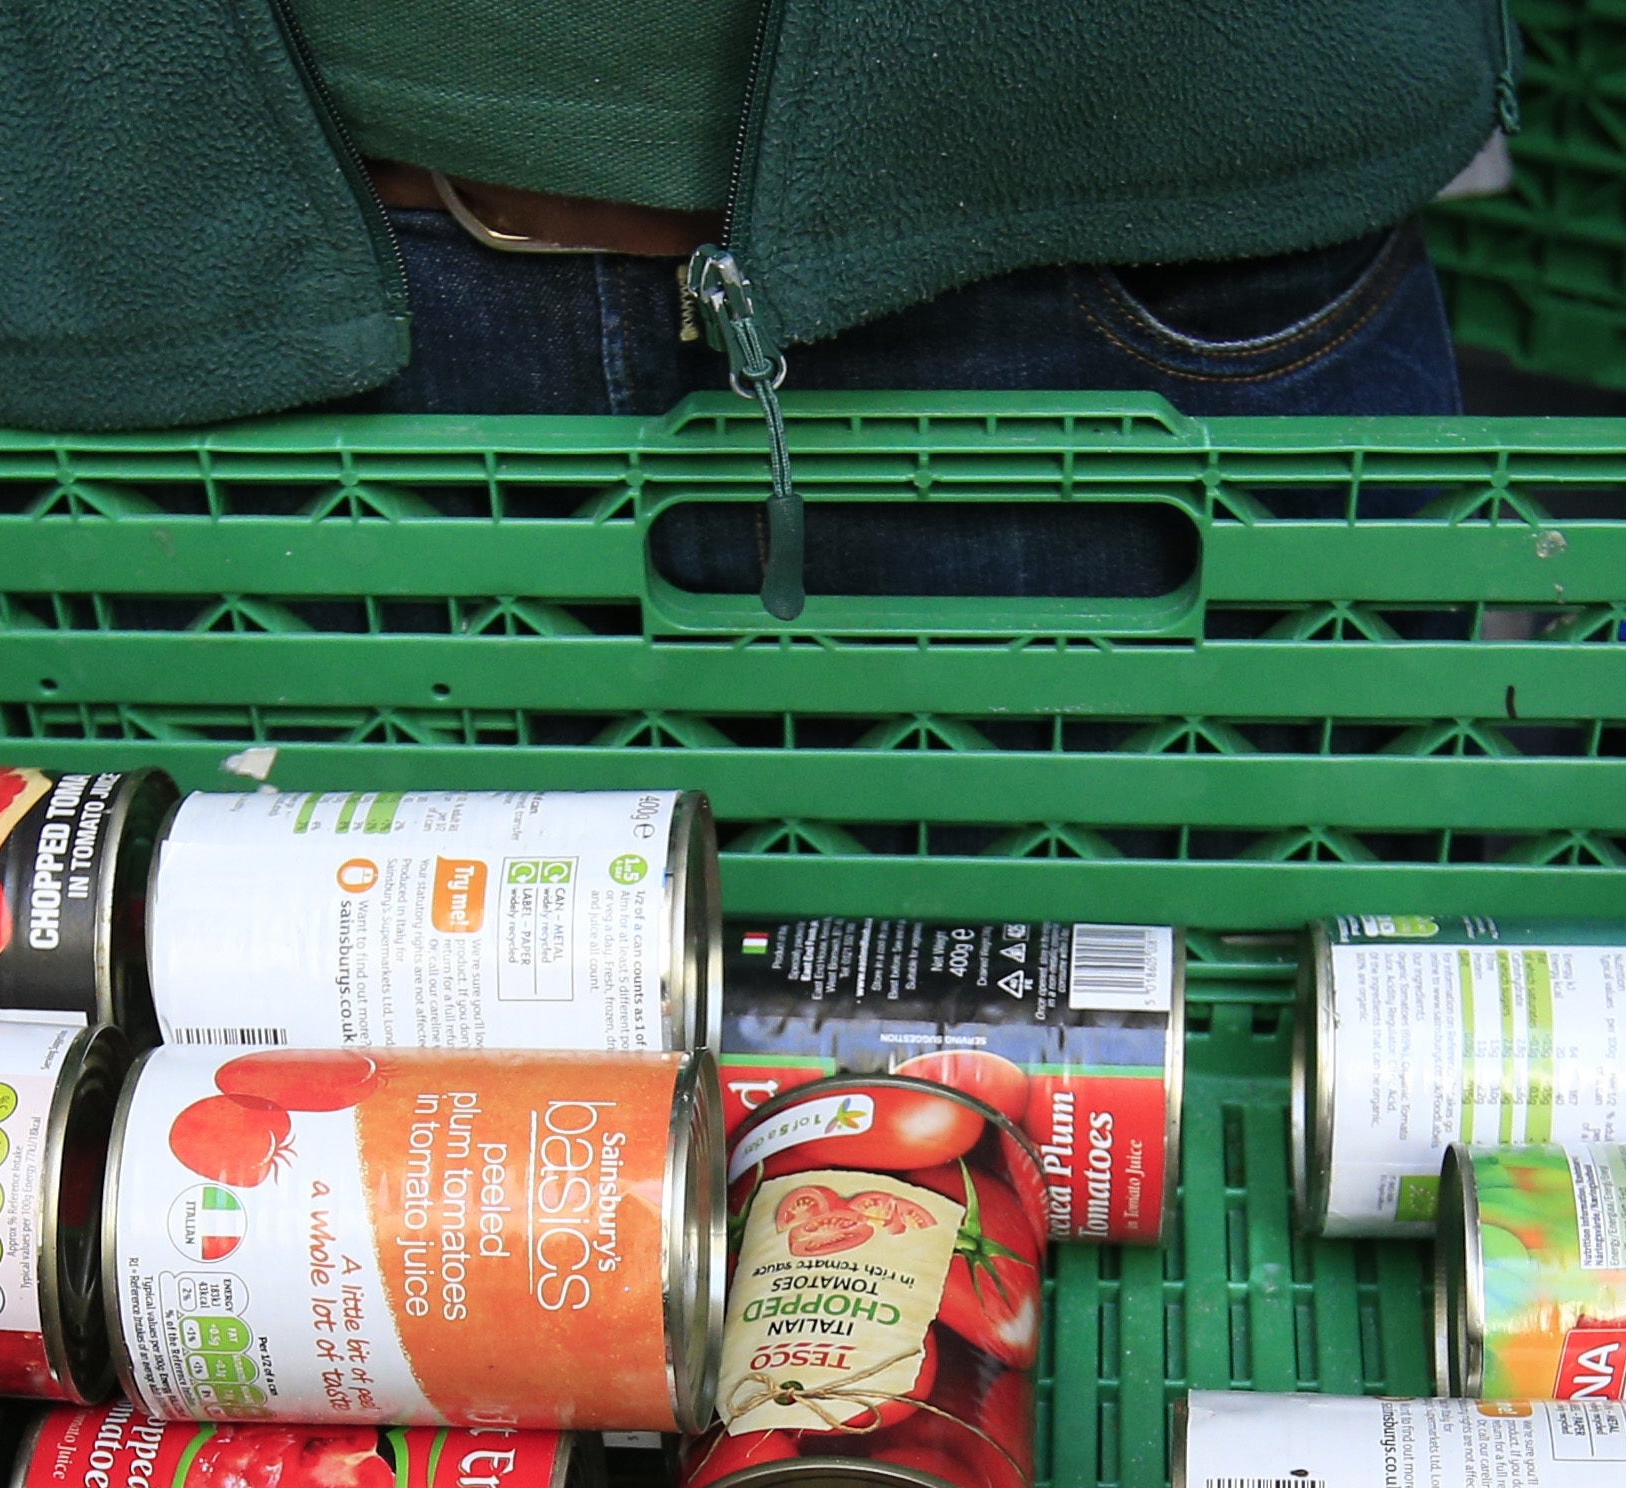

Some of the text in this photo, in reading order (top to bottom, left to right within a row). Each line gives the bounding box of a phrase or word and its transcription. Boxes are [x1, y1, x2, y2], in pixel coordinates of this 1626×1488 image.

[68, 772, 120, 898] IN TOMATO JUICE
[631, 796, 660, 820] 400g
[29, 822, 71, 949] CHOPPED
[448, 865, 476, 926] Try me!
[554, 888, 565, 960] CAN METAL
[380, 859, 397, 992] Sainsbury's Supermarkets
[507, 888, 518, 964] widely recycled
[521, 888, 532, 966] LABEL PAPER
[541, 888, 552, 964] widely recycled
[588, 913, 600, 993] juice count.
[950, 944, 974, 977] 400g
[335, 900, 358, 1043] sainsburys.co.uk
[356, 900, 372, 1046] Want to find out more?
[619, 946, 631, 1033] least different
[634, 934, 646, 1022] can counts as
[880, 1034, 987, 1045] SERVING SUGGESTION
[1040, 1092, 1075, 1177] Plum
[7, 1146, 24, 1257] Approx Reference Intake
[396, 1093, 447, 1318] in tomato juice
[441, 1092, 481, 1321] plum tomatoes
[477, 1142, 511, 1257] peeled
[537, 1101, 618, 1311] basics
[593, 1131, 626, 1271] Sainsbury's
[1078, 1112, 1114, 1236] Tomatoes
[1123, 1139, 1146, 1218] Tomato Juice
[185, 1201, 196, 1244] ITALIAN
[199, 1282, 209, 1308] 43kcal
[210, 1284, 221, 1306] 183kJ
[223, 1279, 232, 1313] ENERGY
[309, 1181, 352, 1411] a whole lot of taste
[743, 1293, 900, 1325] CHOPPED
[752, 1259, 914, 1288] in rich tomato sauce
[771, 1275, 879, 1296] TOMATOES
[341, 1255, 374, 1382] A little bit of
[768, 1318, 854, 1336] ITALIAN
[750, 1350, 851, 1370] TESCO
[1569, 1342, 1621, 1400] NA
[53, 1442, 77, 1480] Juice
